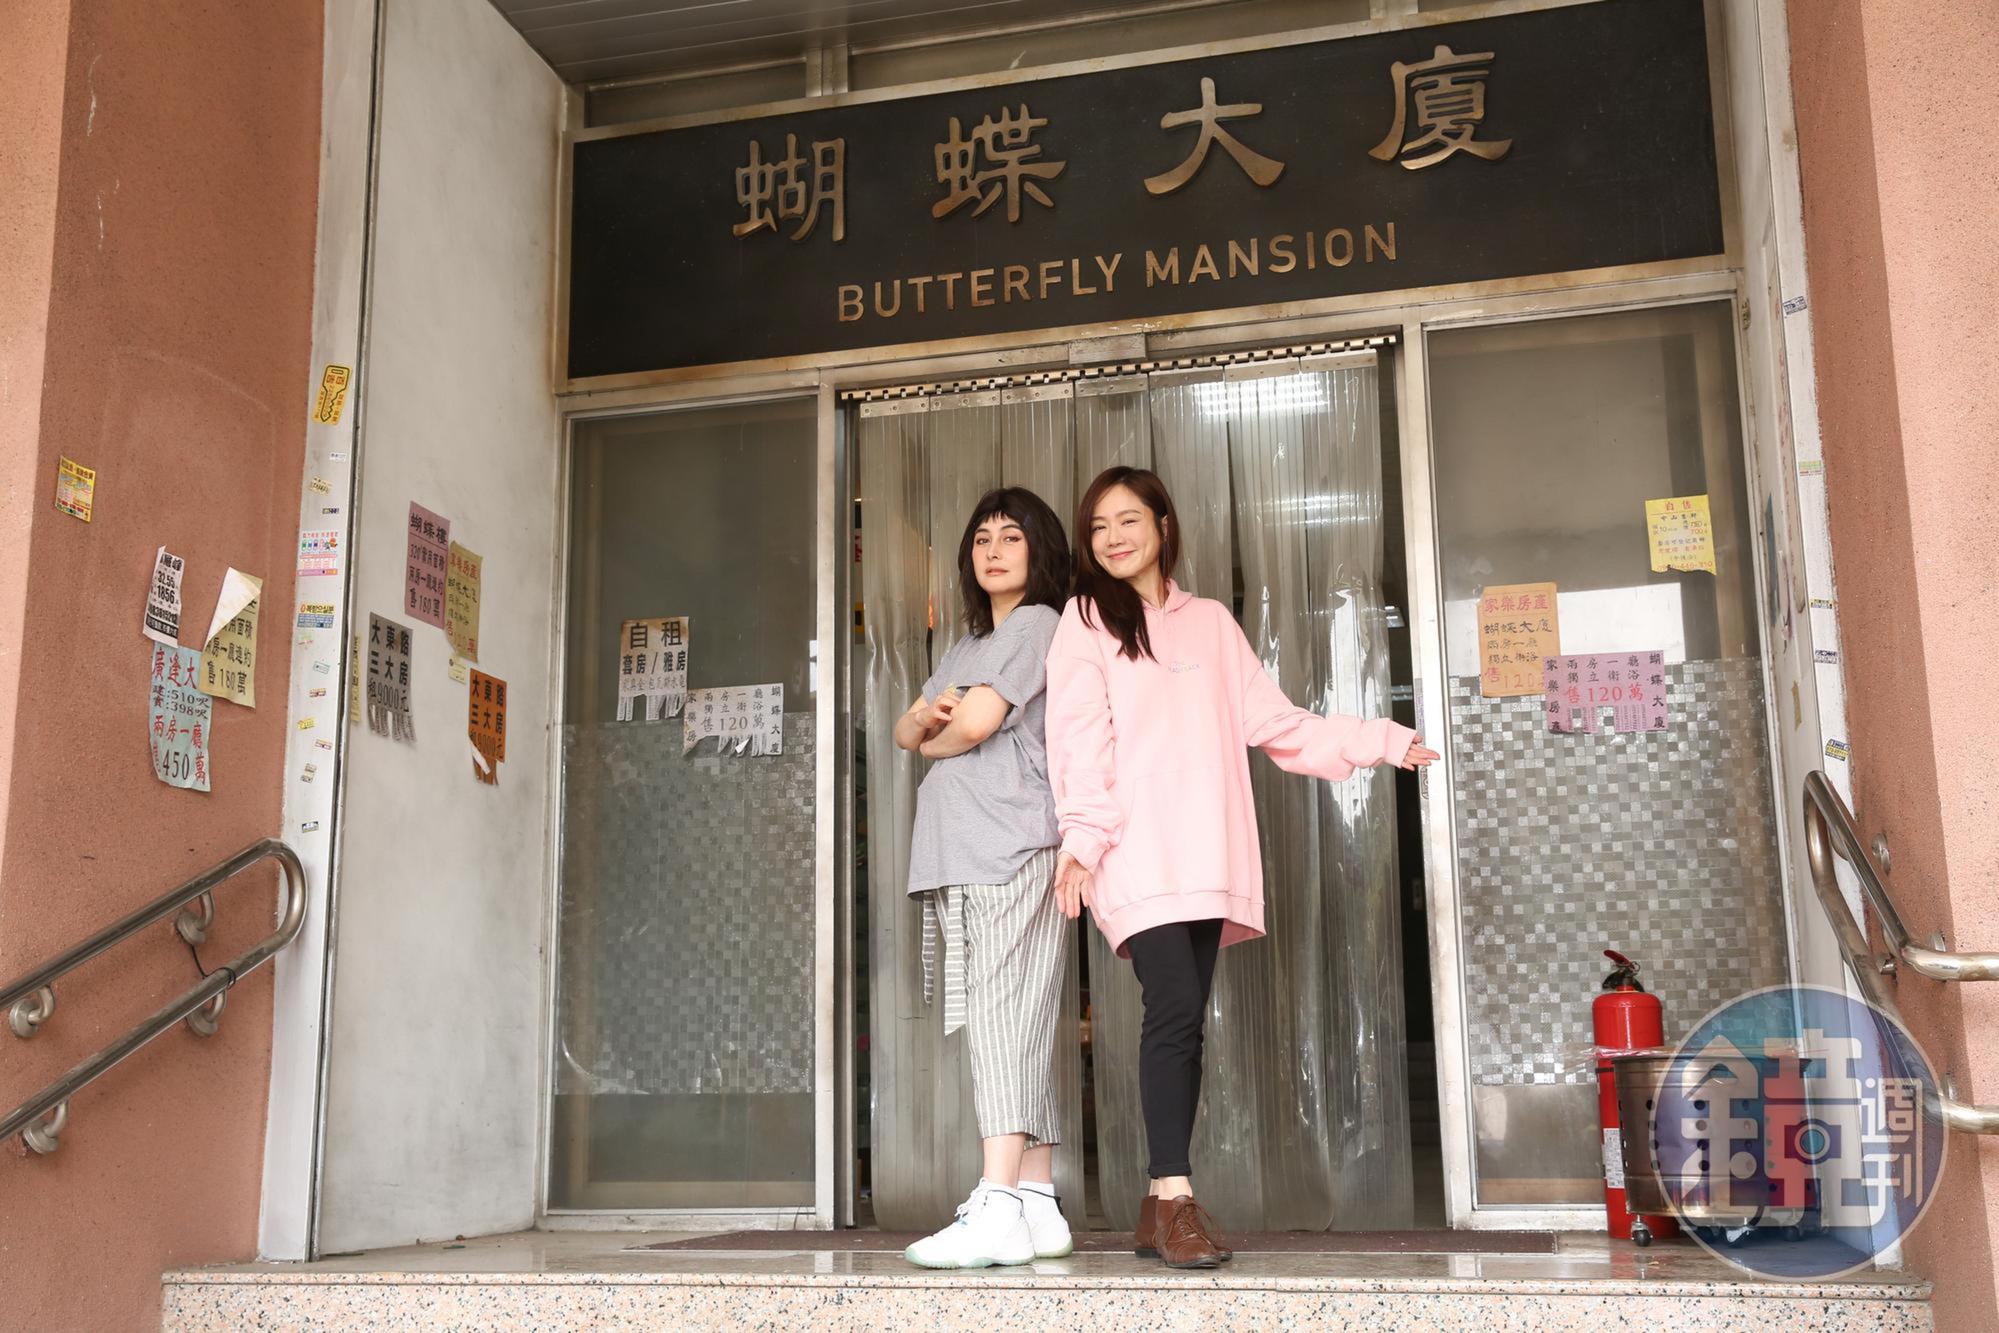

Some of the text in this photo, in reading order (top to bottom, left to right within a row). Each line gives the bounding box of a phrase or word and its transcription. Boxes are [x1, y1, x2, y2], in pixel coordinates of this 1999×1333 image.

[837, 221, 1398, 323] BUTTERFLY MANSION
[372, 620, 410, 656] 大東路
[630, 620, 683, 649] 自租
[370, 650, 409, 686] 三大房
[1484, 666, 1544, 689] 售120
